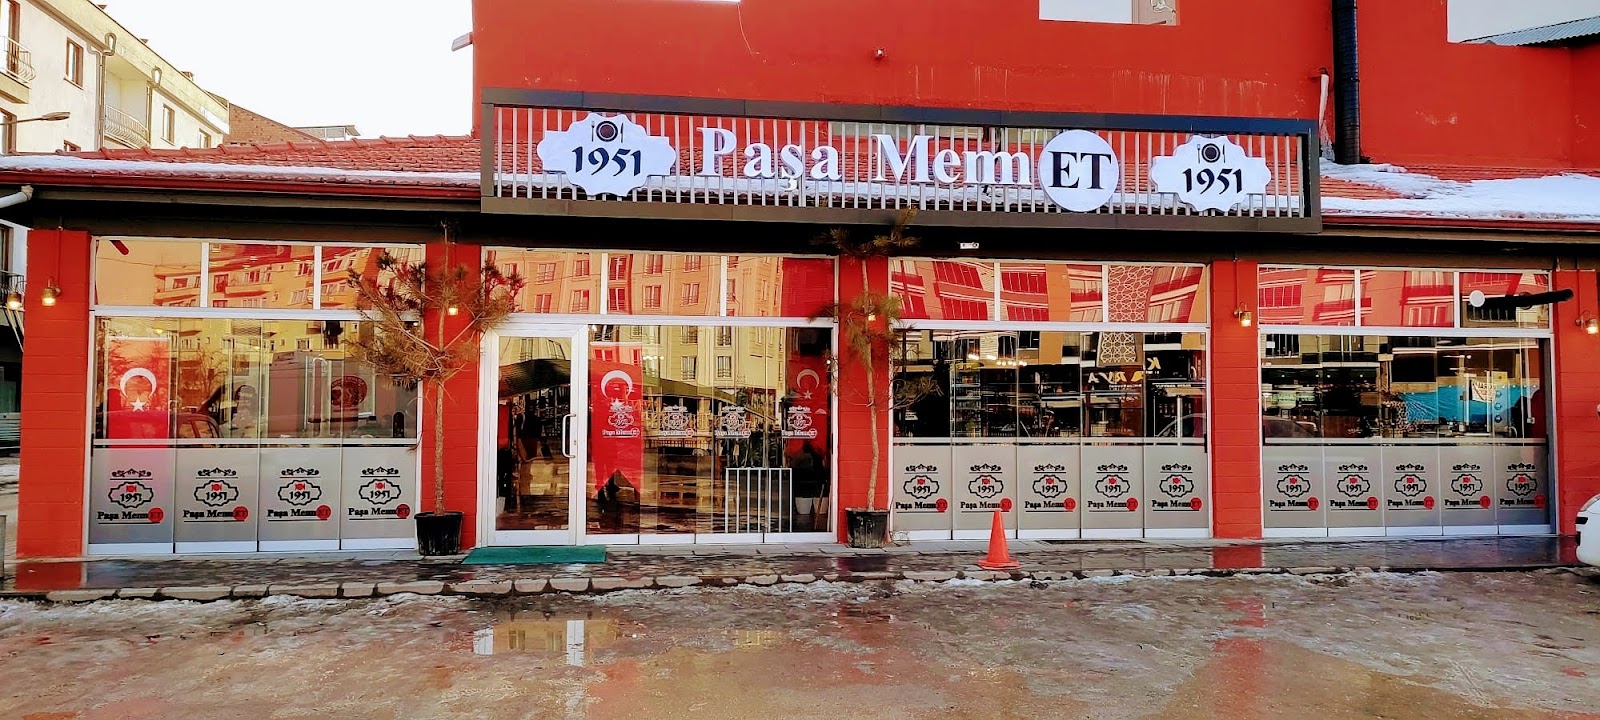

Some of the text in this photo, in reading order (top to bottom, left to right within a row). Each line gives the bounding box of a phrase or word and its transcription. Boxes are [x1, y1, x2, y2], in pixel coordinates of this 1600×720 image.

[571, 145, 642, 177] 1951
[696, 126, 842, 192] Paşa
[1181, 167, 1243, 195] 1951
